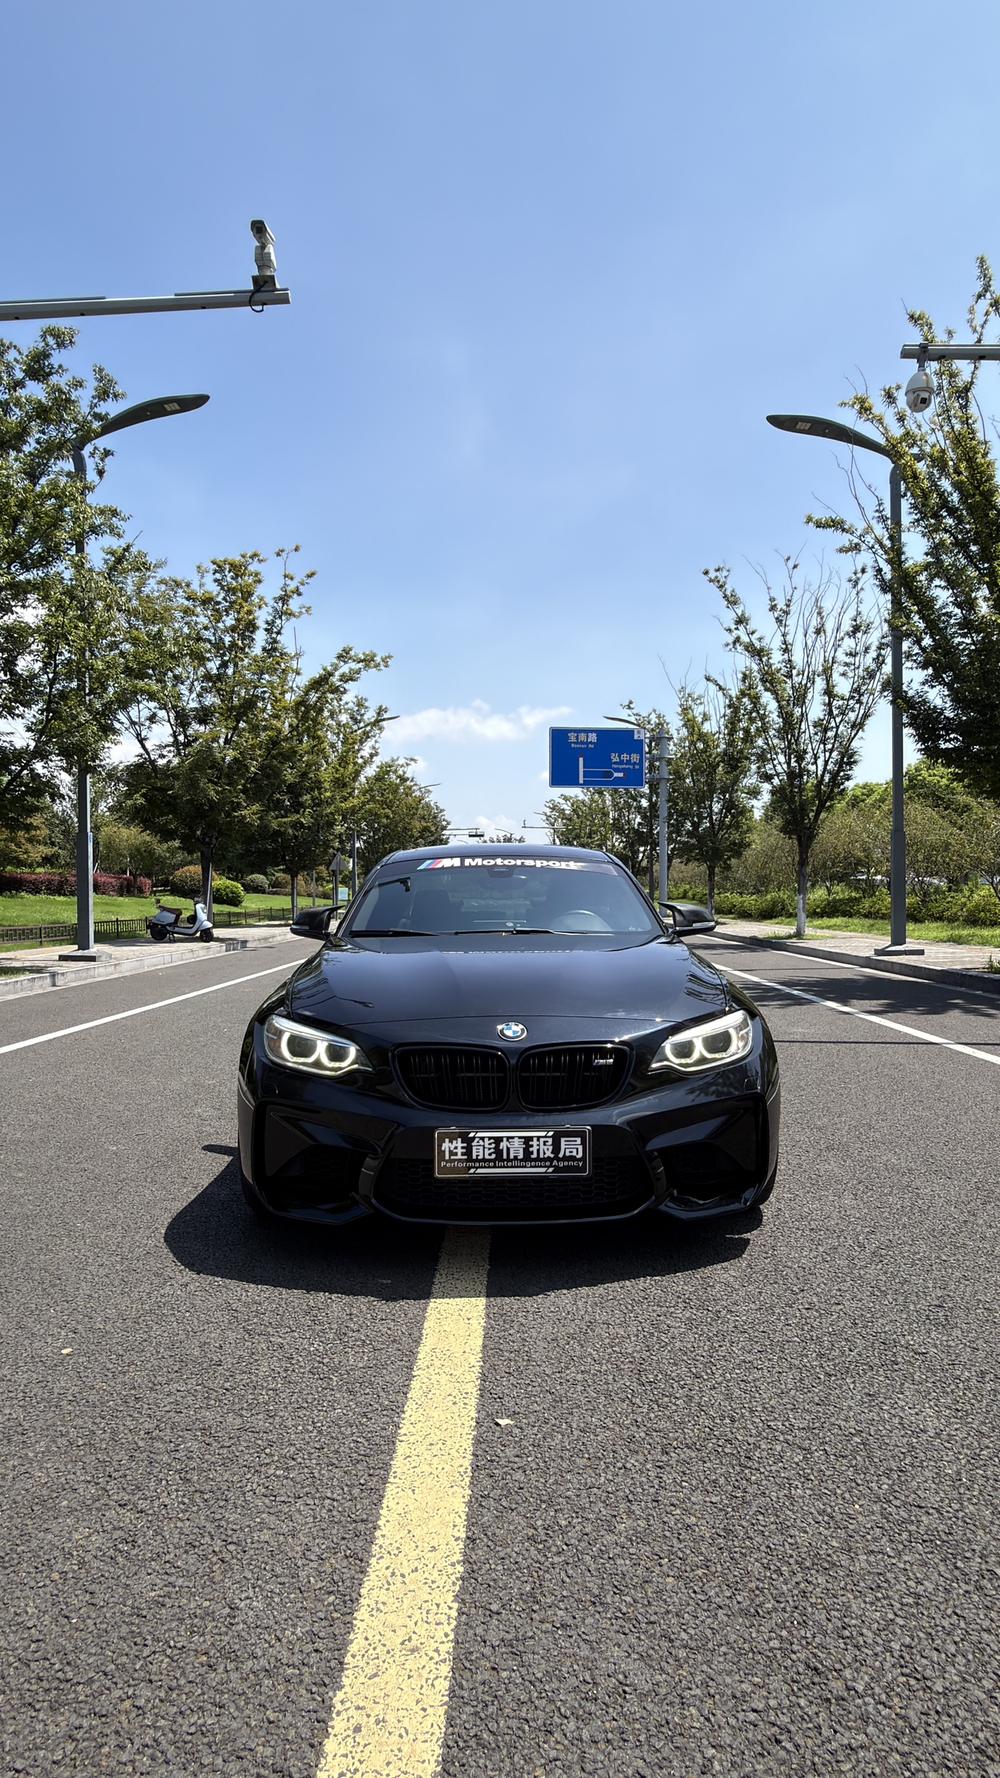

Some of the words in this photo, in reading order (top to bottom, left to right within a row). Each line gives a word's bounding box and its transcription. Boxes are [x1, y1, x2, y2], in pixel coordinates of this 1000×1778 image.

[568, 732, 597, 743] 宝南路
[610, 752, 640, 763] 弘中街
[464, 858, 577, 870] Motorsport
[441, 1137, 583, 1160] 性能情报局
[552, 1159, 583, 1168] Agency
